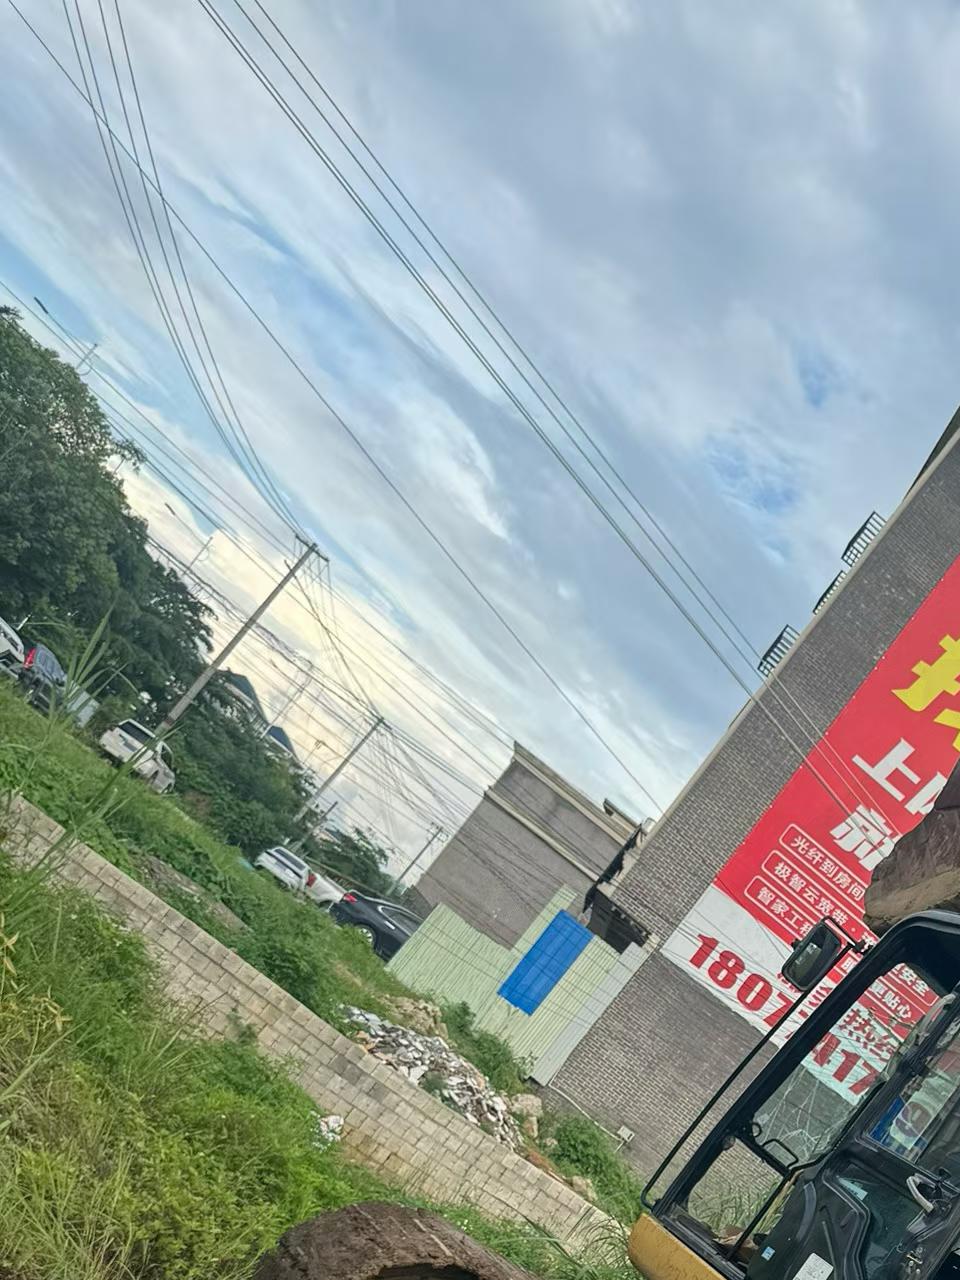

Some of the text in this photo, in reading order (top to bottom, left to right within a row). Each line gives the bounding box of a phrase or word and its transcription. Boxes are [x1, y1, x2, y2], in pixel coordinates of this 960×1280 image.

[790, 836, 866, 902] 光纤到房间
